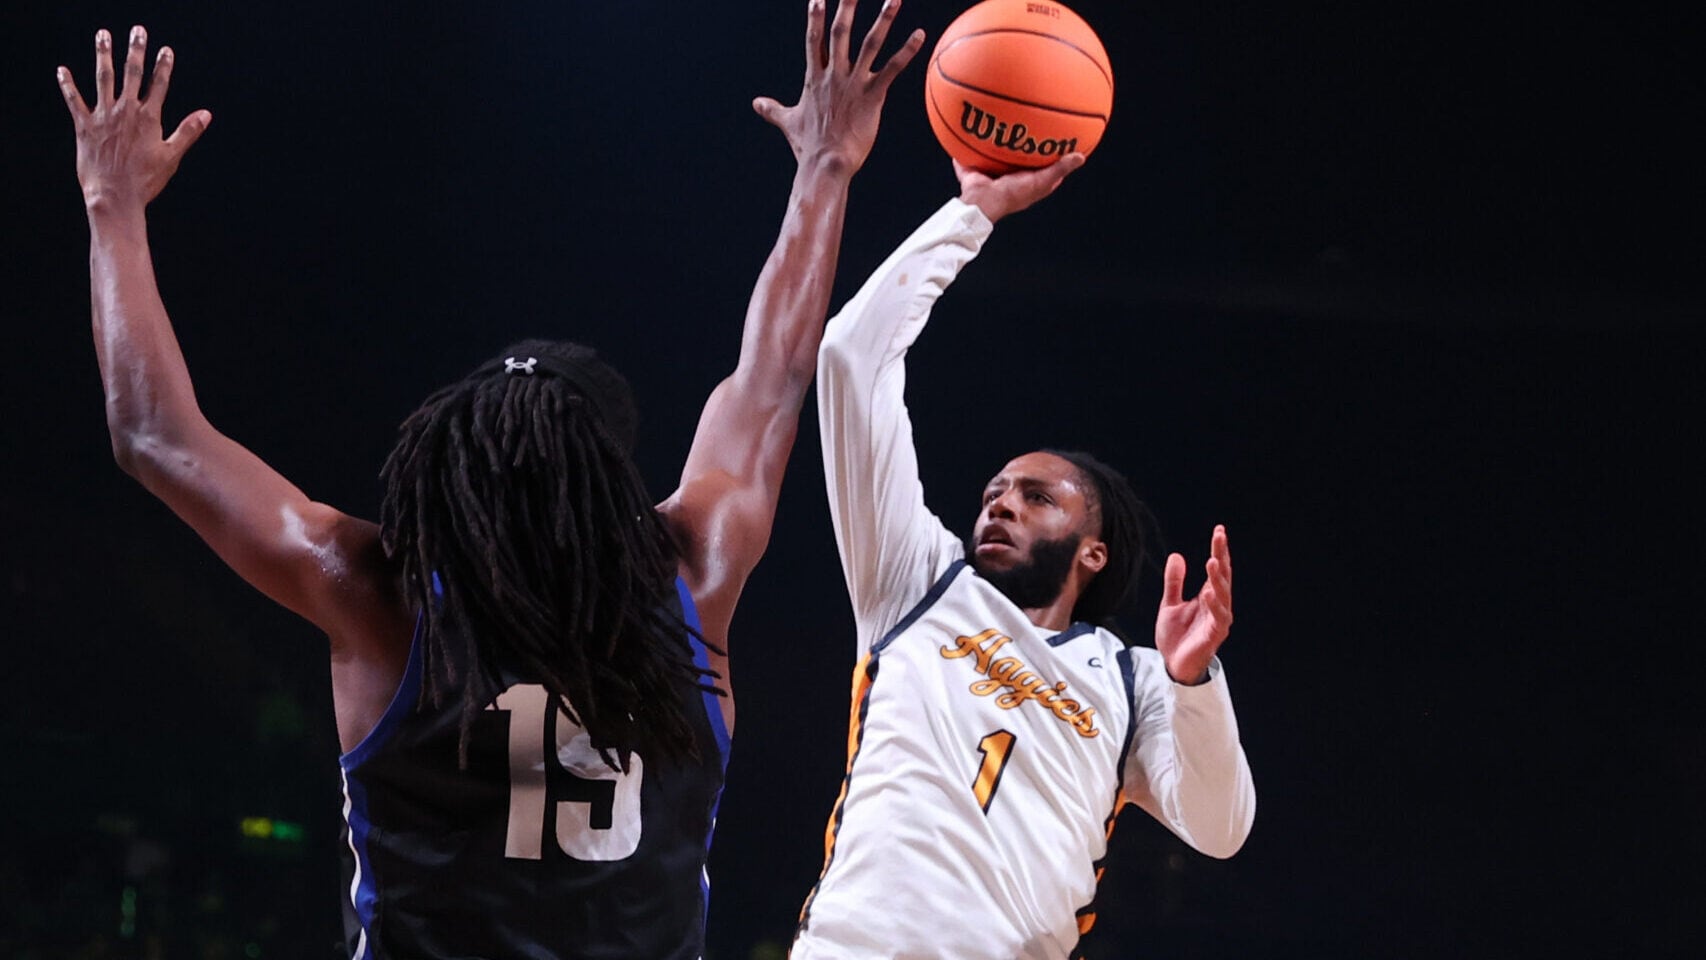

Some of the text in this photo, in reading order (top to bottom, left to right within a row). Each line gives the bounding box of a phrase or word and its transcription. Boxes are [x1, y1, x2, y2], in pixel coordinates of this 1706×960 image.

[961, 100, 1077, 156] Wilson
[940, 628, 1099, 738] Aggies
[971, 728, 1017, 816] 1
